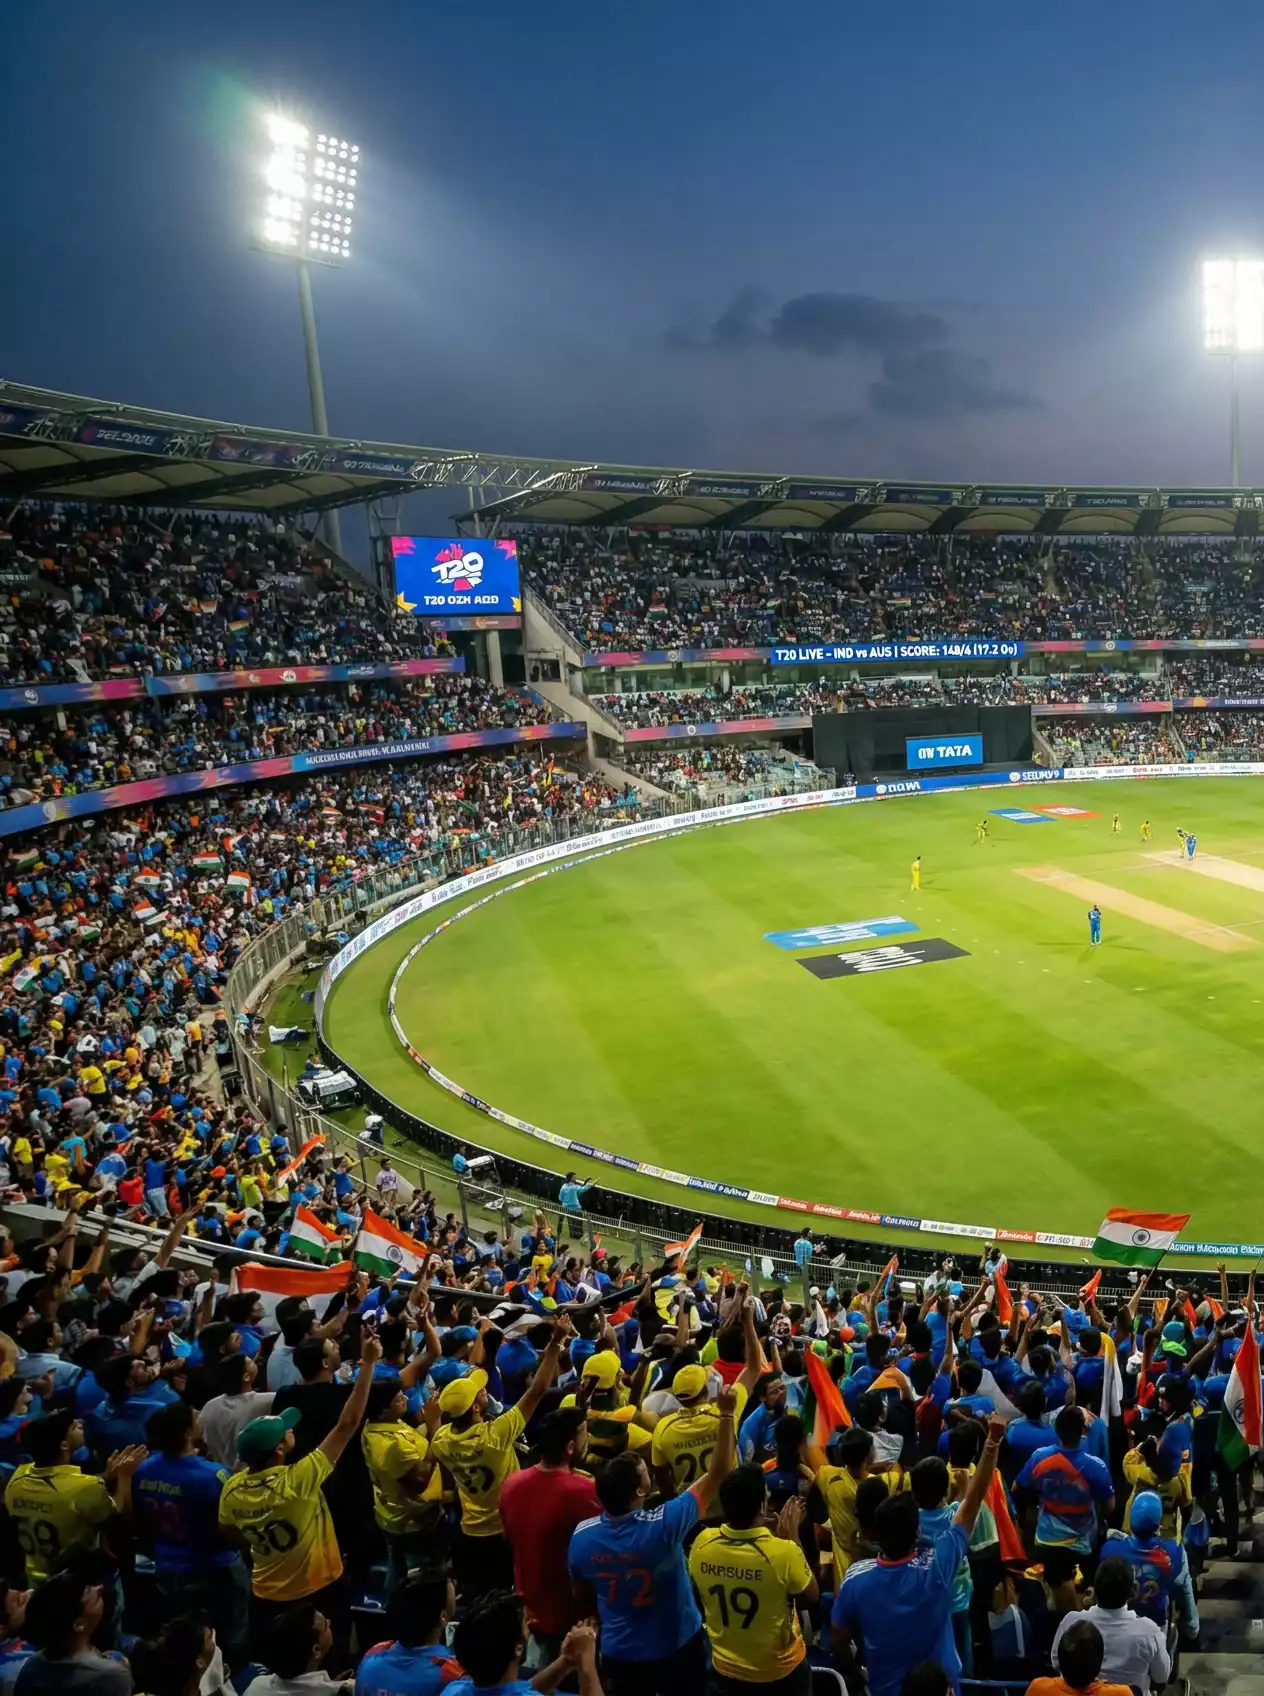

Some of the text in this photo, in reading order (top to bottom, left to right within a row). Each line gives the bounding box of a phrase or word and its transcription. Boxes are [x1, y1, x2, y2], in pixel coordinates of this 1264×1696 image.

[424, 595, 445, 605] T20
[776, 650, 797, 661] T20
[799, 648, 824, 660] LIVE
[834, 647, 854, 659] IND
[869, 646, 892, 658] AUS
[900, 645, 940, 657] SCORE:
[937, 744, 973, 758] TATA
[595, 1567, 658, 1608] 72
[708, 1584, 760, 1629] 19
